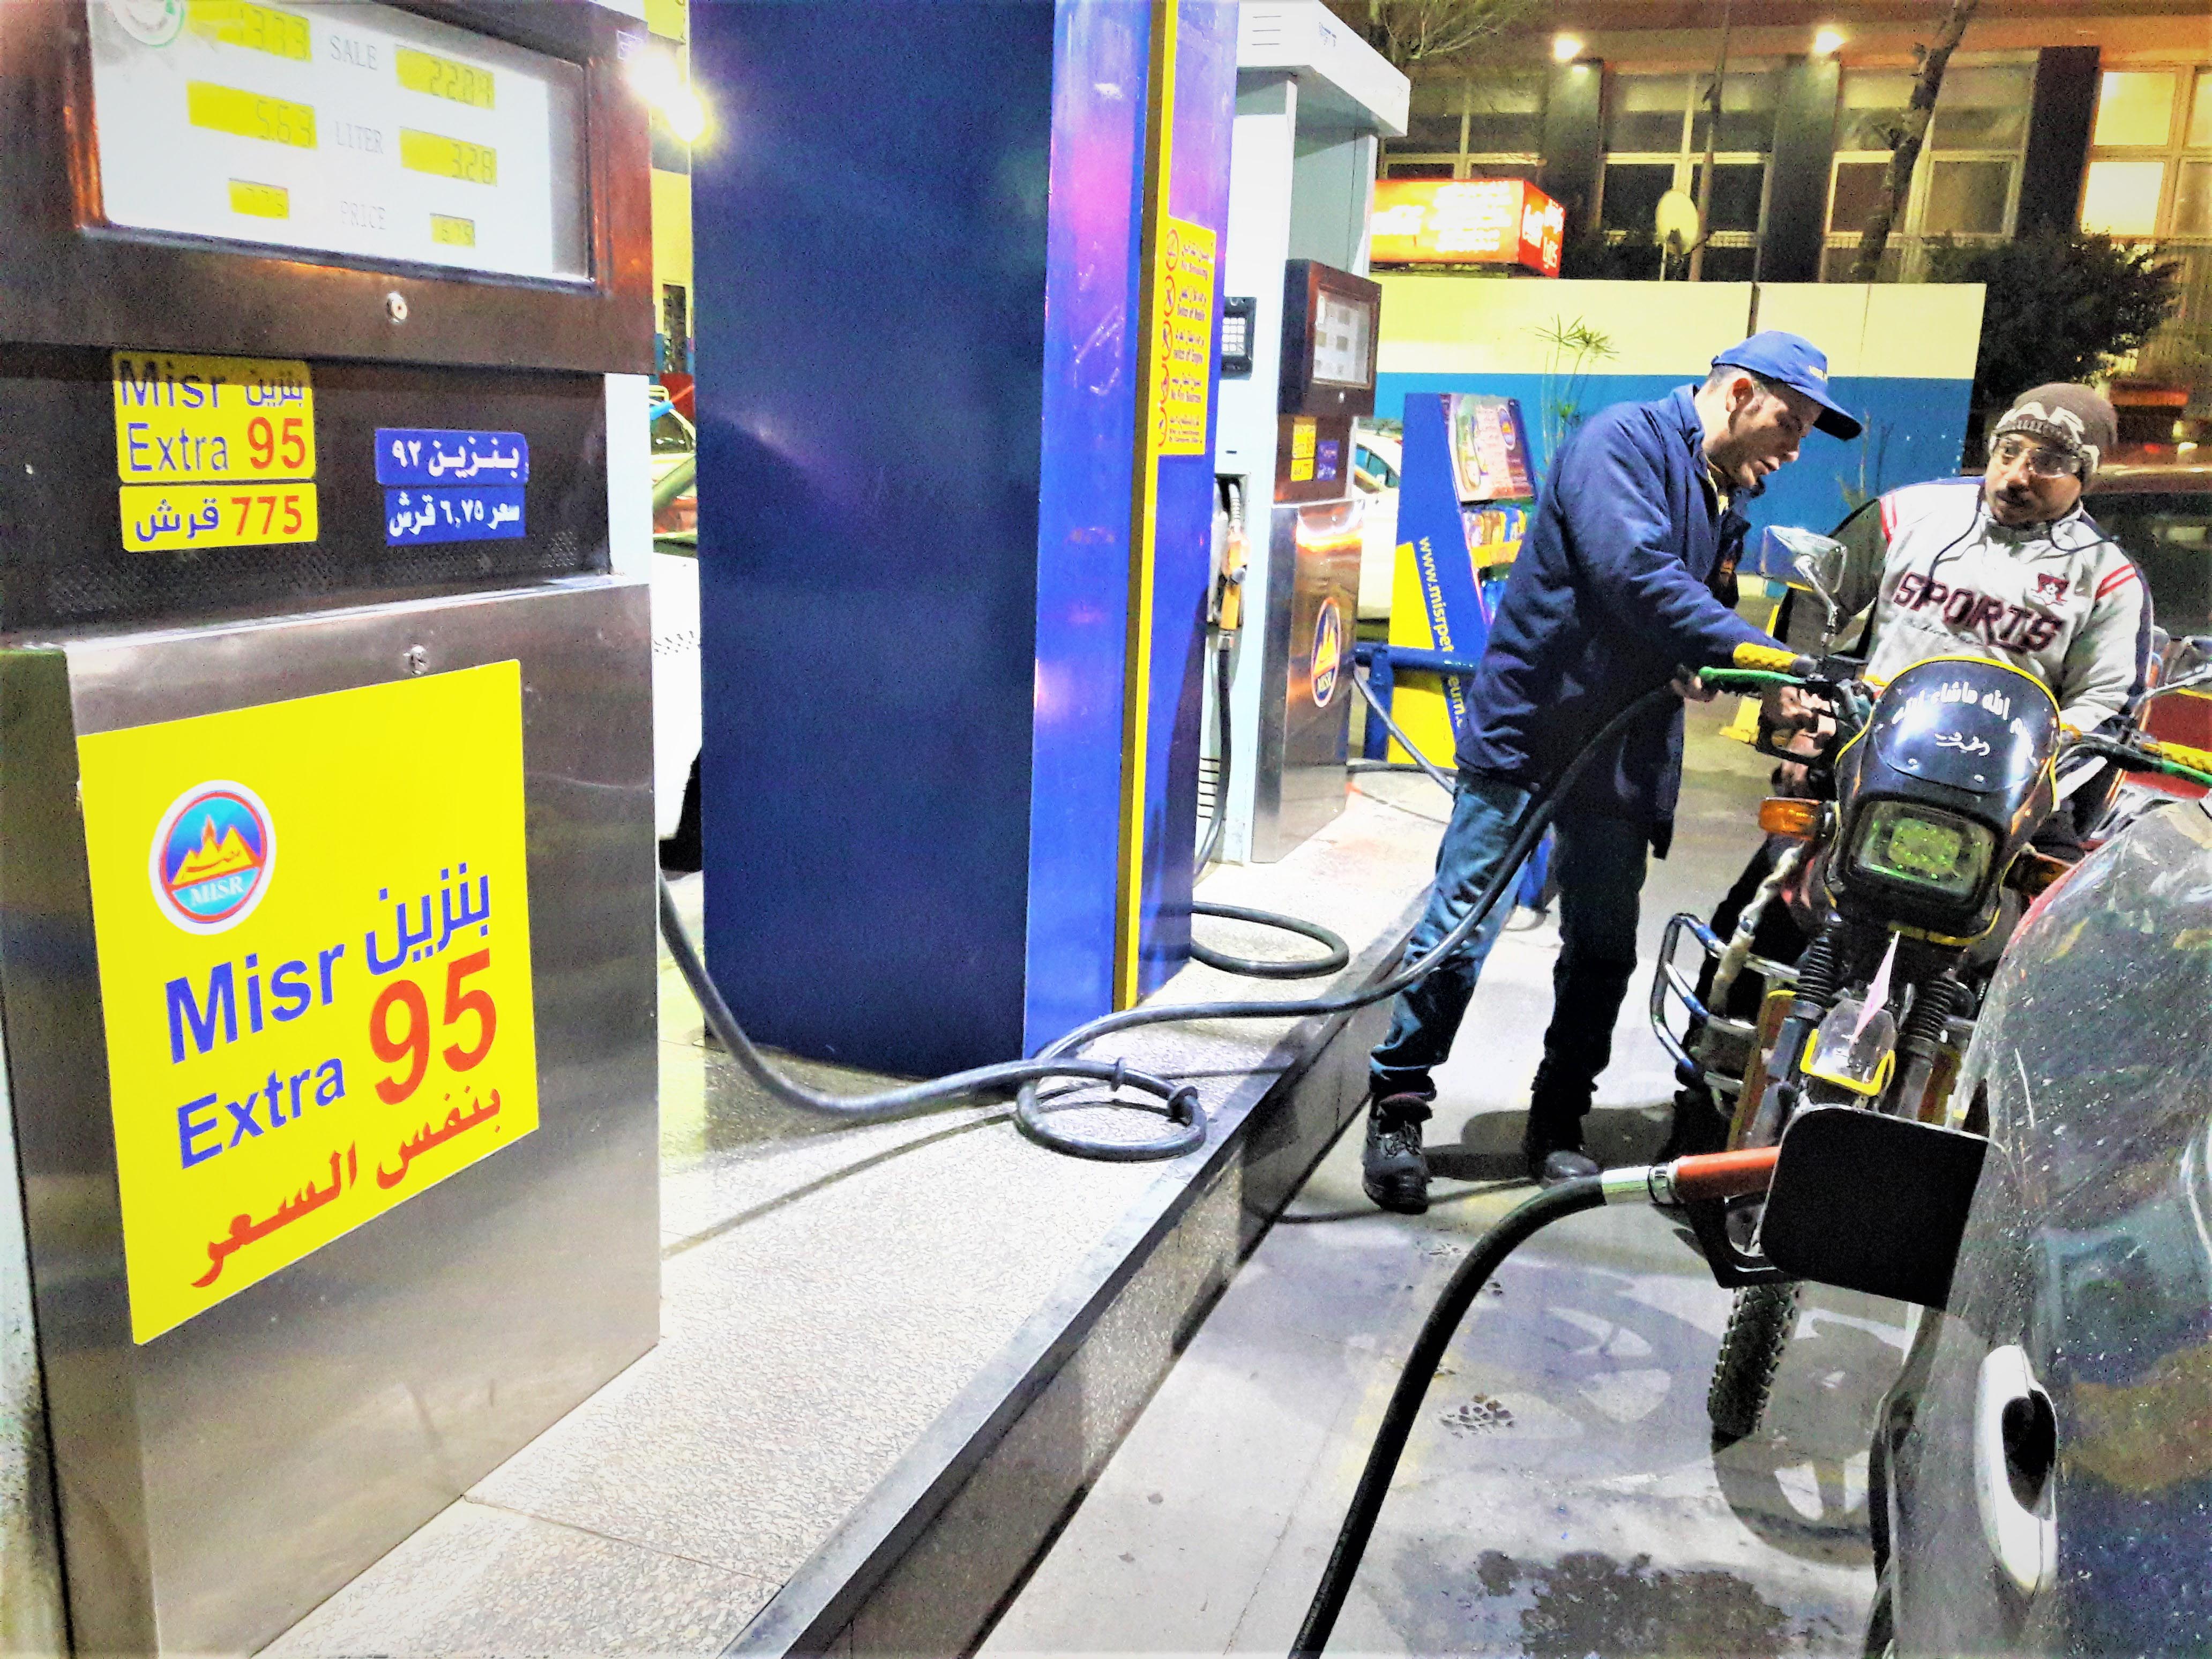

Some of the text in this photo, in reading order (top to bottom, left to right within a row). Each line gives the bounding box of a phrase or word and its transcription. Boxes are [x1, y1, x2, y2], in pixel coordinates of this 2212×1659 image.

[330, 35, 377, 71] SALE
[256, 99, 312, 147] 5.63
[335, 121, 384, 155] LITER
[339, 199, 386, 230] PRICE
[119, 360, 225, 409] Misr
[127, 416, 305, 471] Extra 95
[428, 435, 519, 479] بنزين
[135, 495, 302, 542] 775 قرش
[388, 491, 436, 537] قرش
[487, 503, 520, 530] سعر
[1893, 571, 2065, 654] SPORTS
[191, 876, 245, 907] MISR
[365, 861, 491, 975] بنزين
[165, 943, 345, 1065] Misr
[176, 947, 498, 1170] Extra 95
[191, 1085, 503, 1288] بنفس السعر
